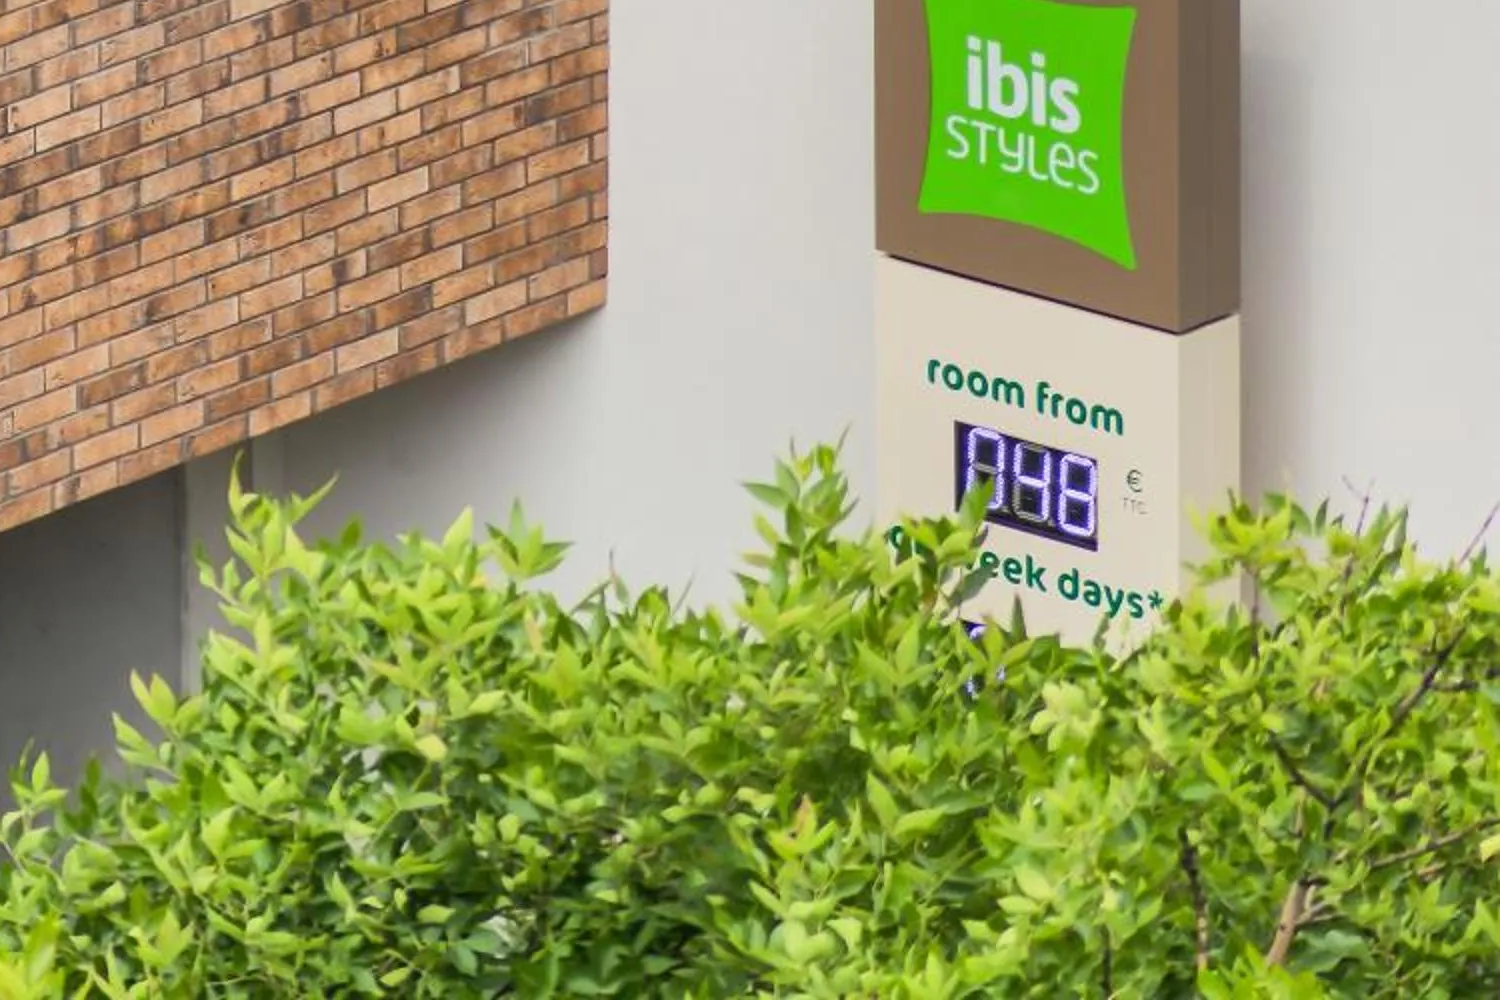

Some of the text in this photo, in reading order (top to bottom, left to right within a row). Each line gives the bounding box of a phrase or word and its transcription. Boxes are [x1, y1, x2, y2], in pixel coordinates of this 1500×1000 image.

[966, 34, 1082, 134] ibis
[926, 358, 1124, 436] room from
[1125, 468, 1144, 493] €
[964, 550, 1048, 592] eek
